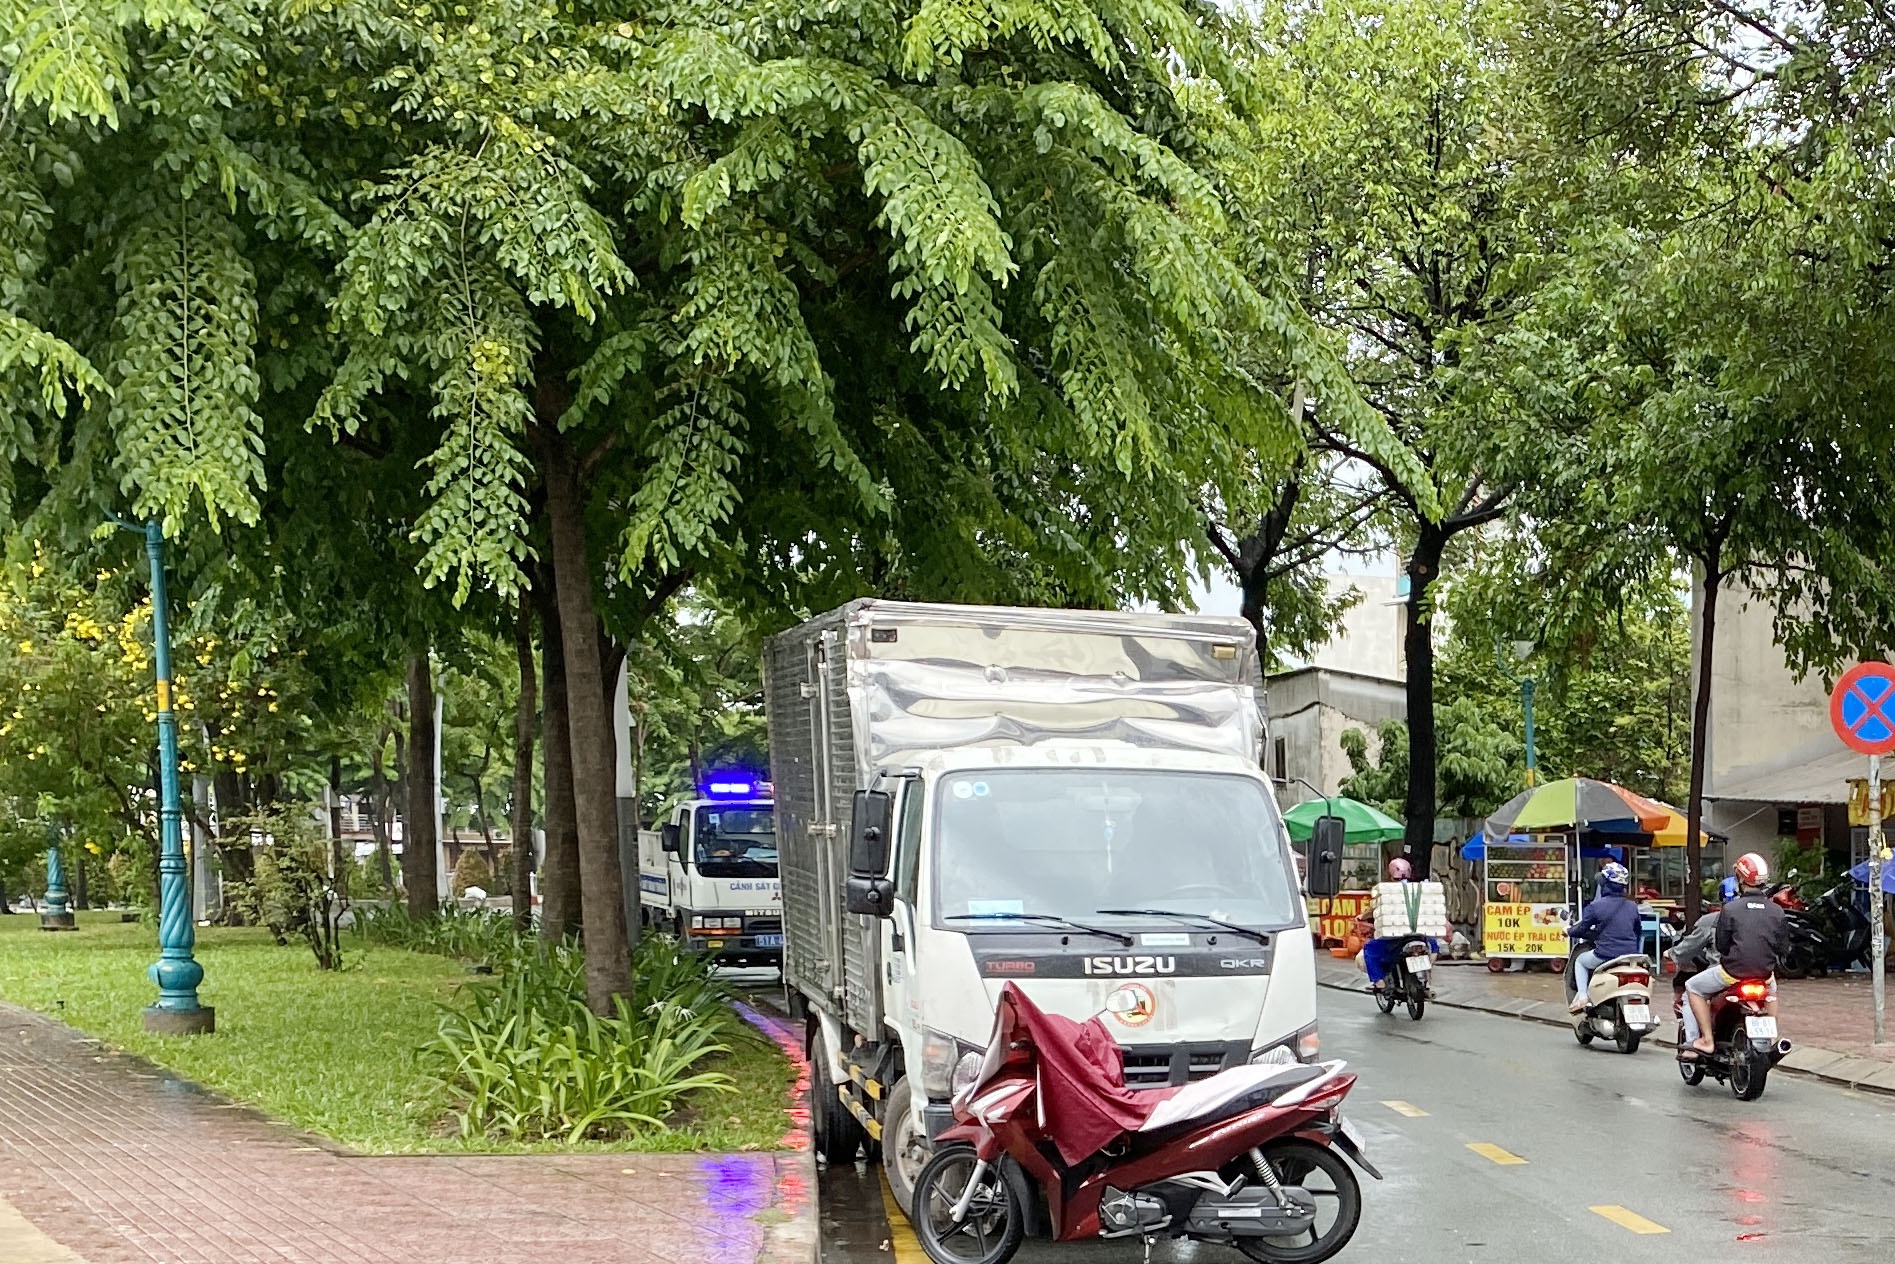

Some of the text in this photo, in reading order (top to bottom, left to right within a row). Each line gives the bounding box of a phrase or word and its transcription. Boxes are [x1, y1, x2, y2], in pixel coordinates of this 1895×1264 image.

[1486, 904, 1531, 916] CAM ÉP
[1497, 918, 1520, 928] 10K
[1497, 943, 1516, 953] 15K
[1525, 943, 1544, 953] 20K
[985, 961, 1036, 973] TURBO
[1083, 956, 1176, 975] ISUZU
[1220, 958, 1265, 969] QKR
